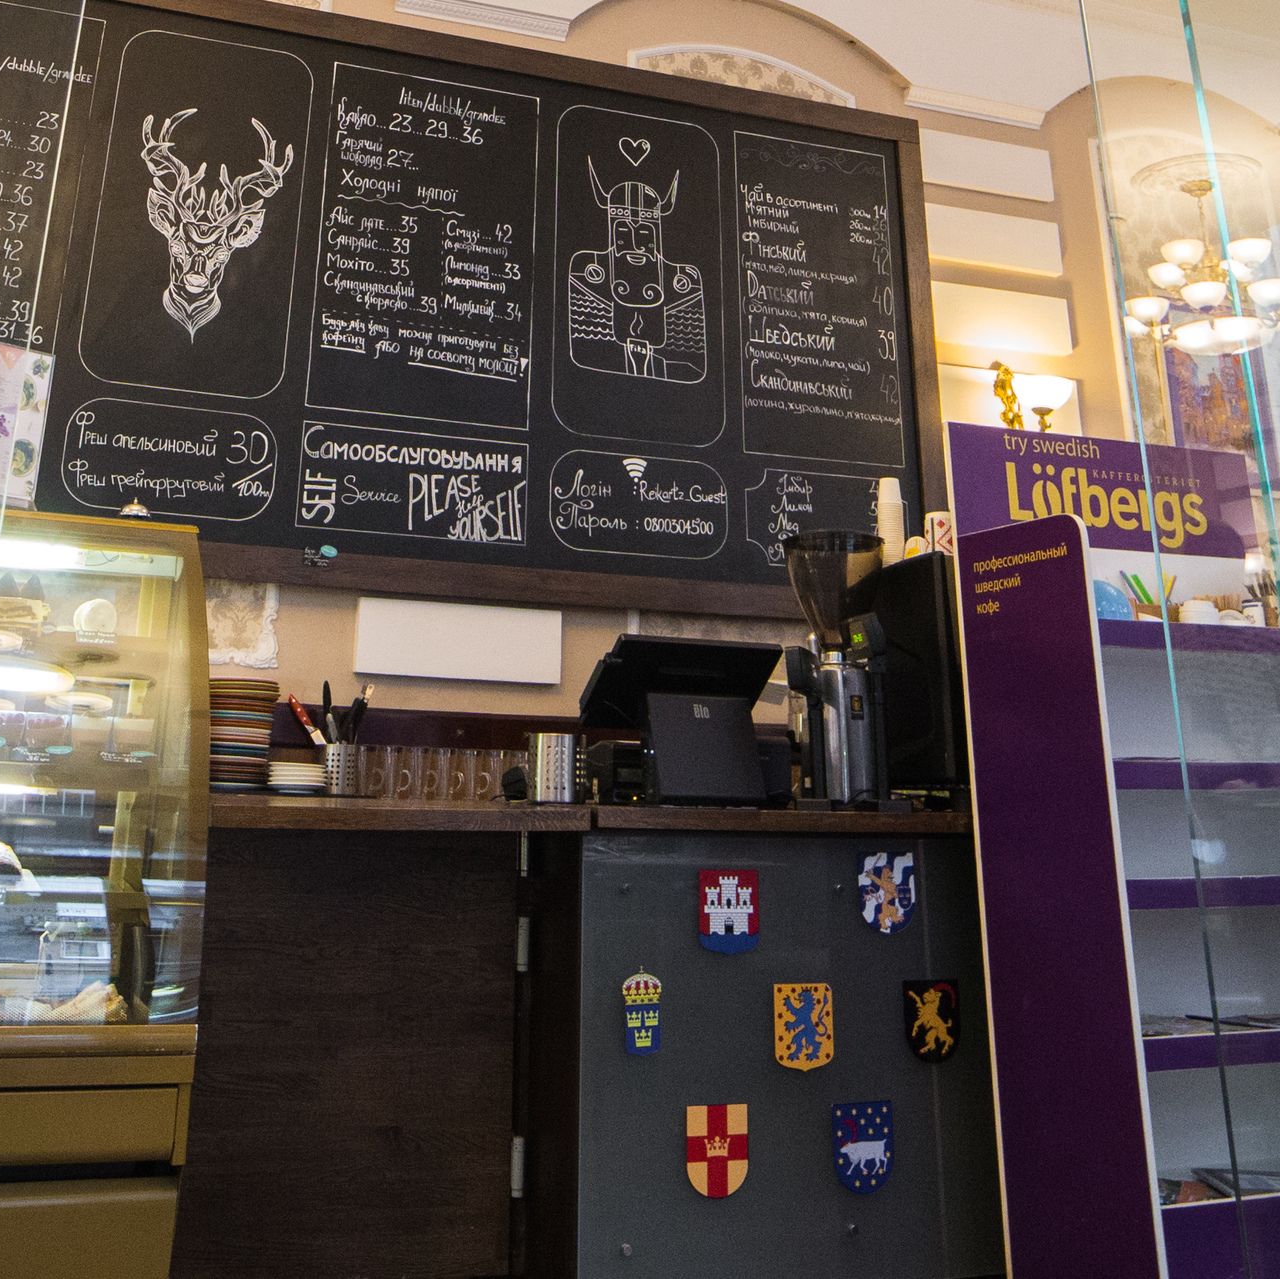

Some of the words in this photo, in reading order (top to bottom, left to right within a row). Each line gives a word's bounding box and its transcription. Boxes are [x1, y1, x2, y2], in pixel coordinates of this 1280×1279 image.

[36, 111, 60, 131] 23
[389, 112, 413, 133] 23
[425, 119, 447, 139] 29
[459, 126, 484, 145] 36
[27, 135, 51, 154] 30
[387, 149, 415, 168] 27
[22, 161, 44, 180] 23
[340, 168, 401, 198] Холодні
[10, 185, 33, 206] 36
[2, 211, 29, 233] 37
[874, 205, 887, 220] 14
[399, 216, 418, 234] 35
[495, 223, 513, 245] 42
[3, 239, 24, 261] 42
[391, 238, 411, 255] 39
[326, 252, 374, 272] Мохіто
[389, 259, 410, 277] 35
[502, 262, 521, 280] 33
[2, 266, 23, 288] 42
[6, 300, 30, 323] 39
[419, 296, 437, 314] 39
[505, 302, 522, 322] 34
[878, 329, 896, 361] 39
[226, 430, 269, 465] 30
[1003, 432, 1028, 455] try
[1032, 436, 1100, 459] swedish
[341, 474, 402, 505] Service
[408, 472, 481, 531] PLEASE
[972, 543, 1067, 574] профессиональный
[974, 572, 1021, 595] шведский
[976, 599, 1000, 616] кофе
